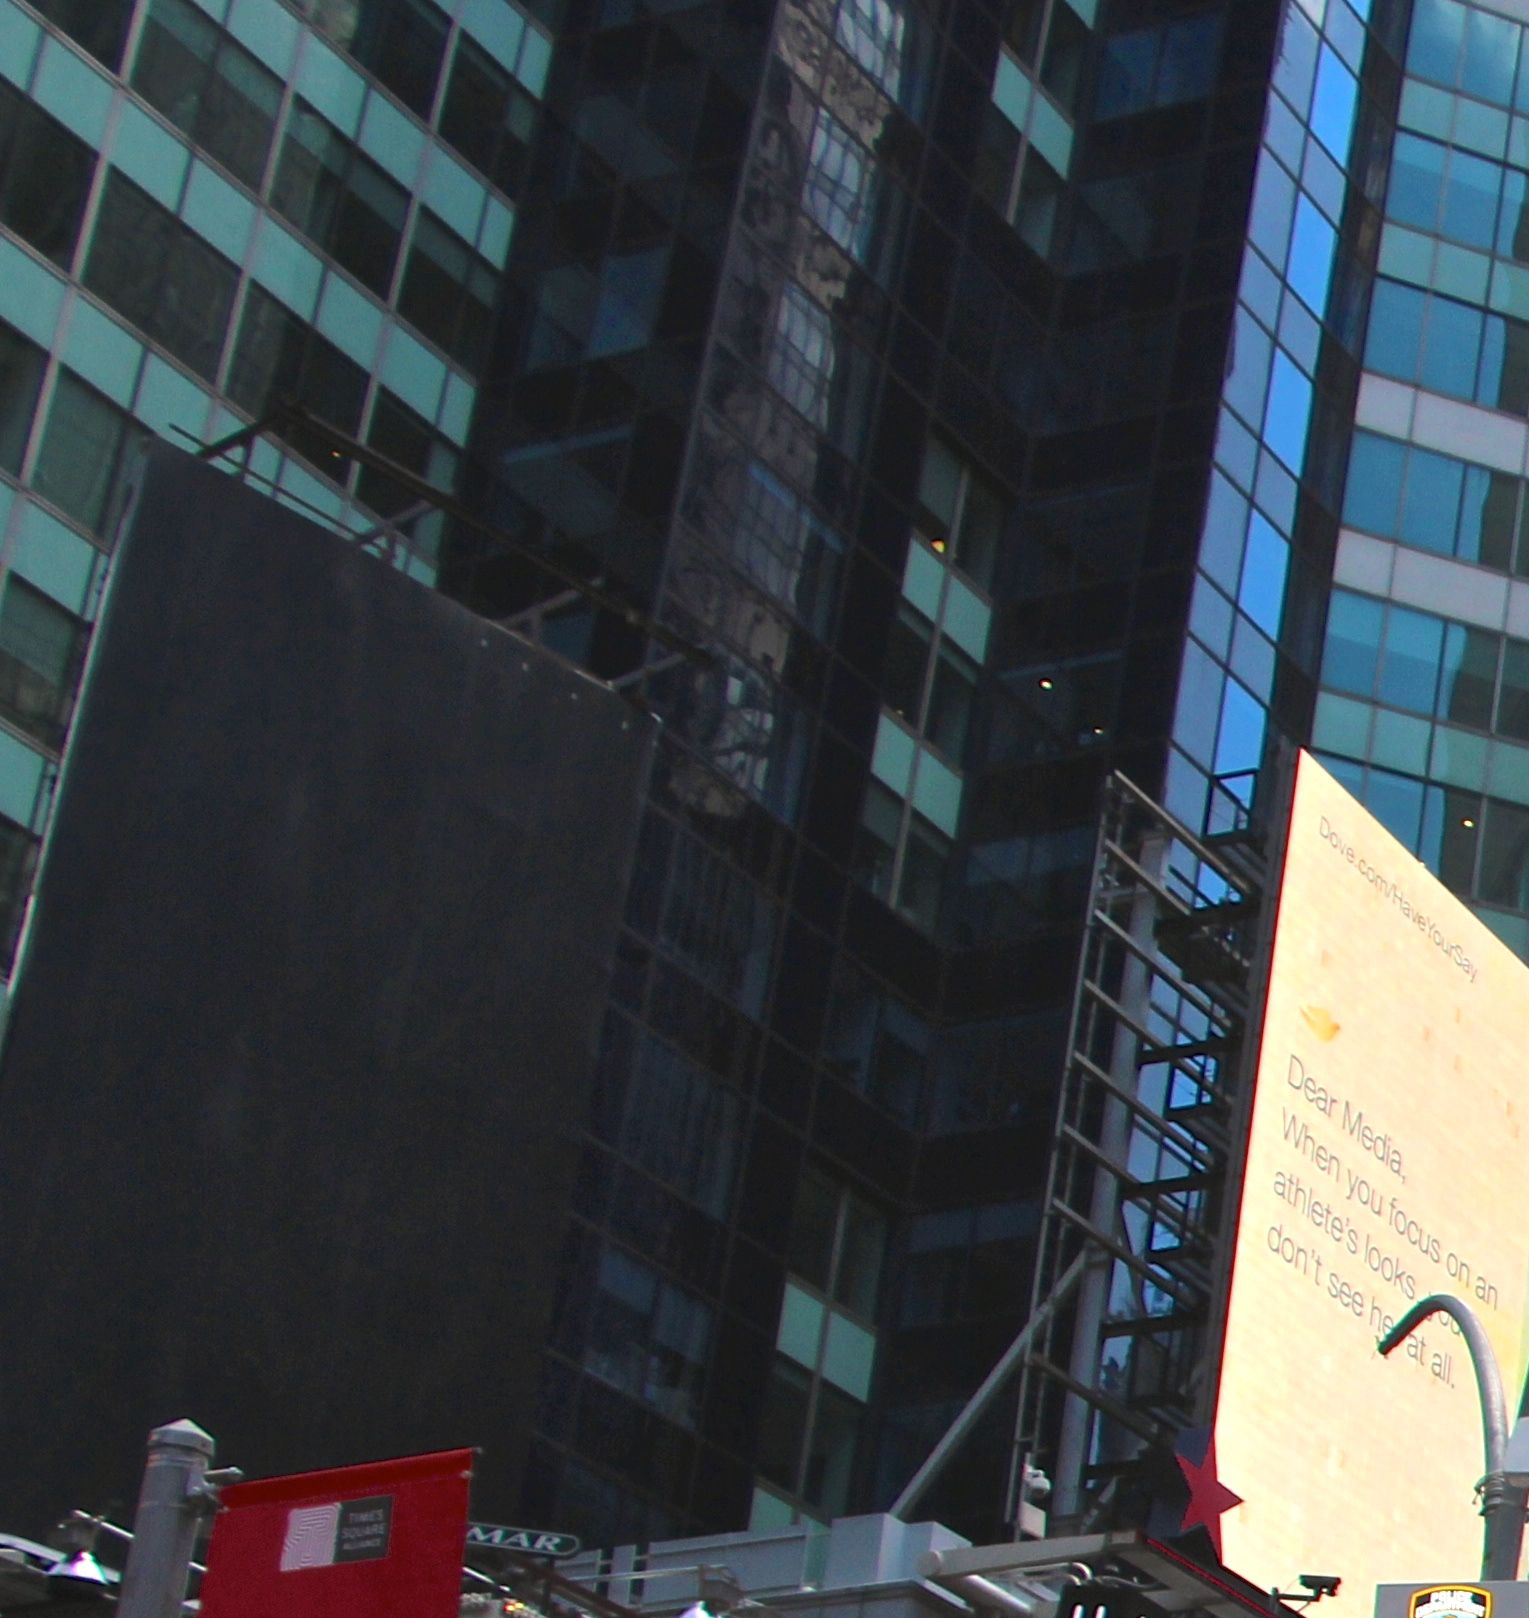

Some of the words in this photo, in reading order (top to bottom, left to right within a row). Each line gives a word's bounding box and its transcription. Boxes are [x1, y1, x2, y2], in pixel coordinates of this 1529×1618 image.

[1287, 1053, 1338, 1119] Dear
[1341, 1109, 1407, 1186] Media,
[1273, 1169, 1359, 1255] athlete's
[1364, 1232, 1417, 1304] looks
[1281, 1107, 1342, 1178] When
[1346, 1159, 1384, 1216] you
[1388, 1186, 1443, 1262] focus
[1446, 1250, 1472, 1285] on
[1475, 1277, 1501, 1313] an
[1266, 1221, 1323, 1290] don't
[1329, 1271, 1365, 1319] see
[1405, 1330, 1427, 1369] at
[1431, 1343, 1457, 1392] all.
